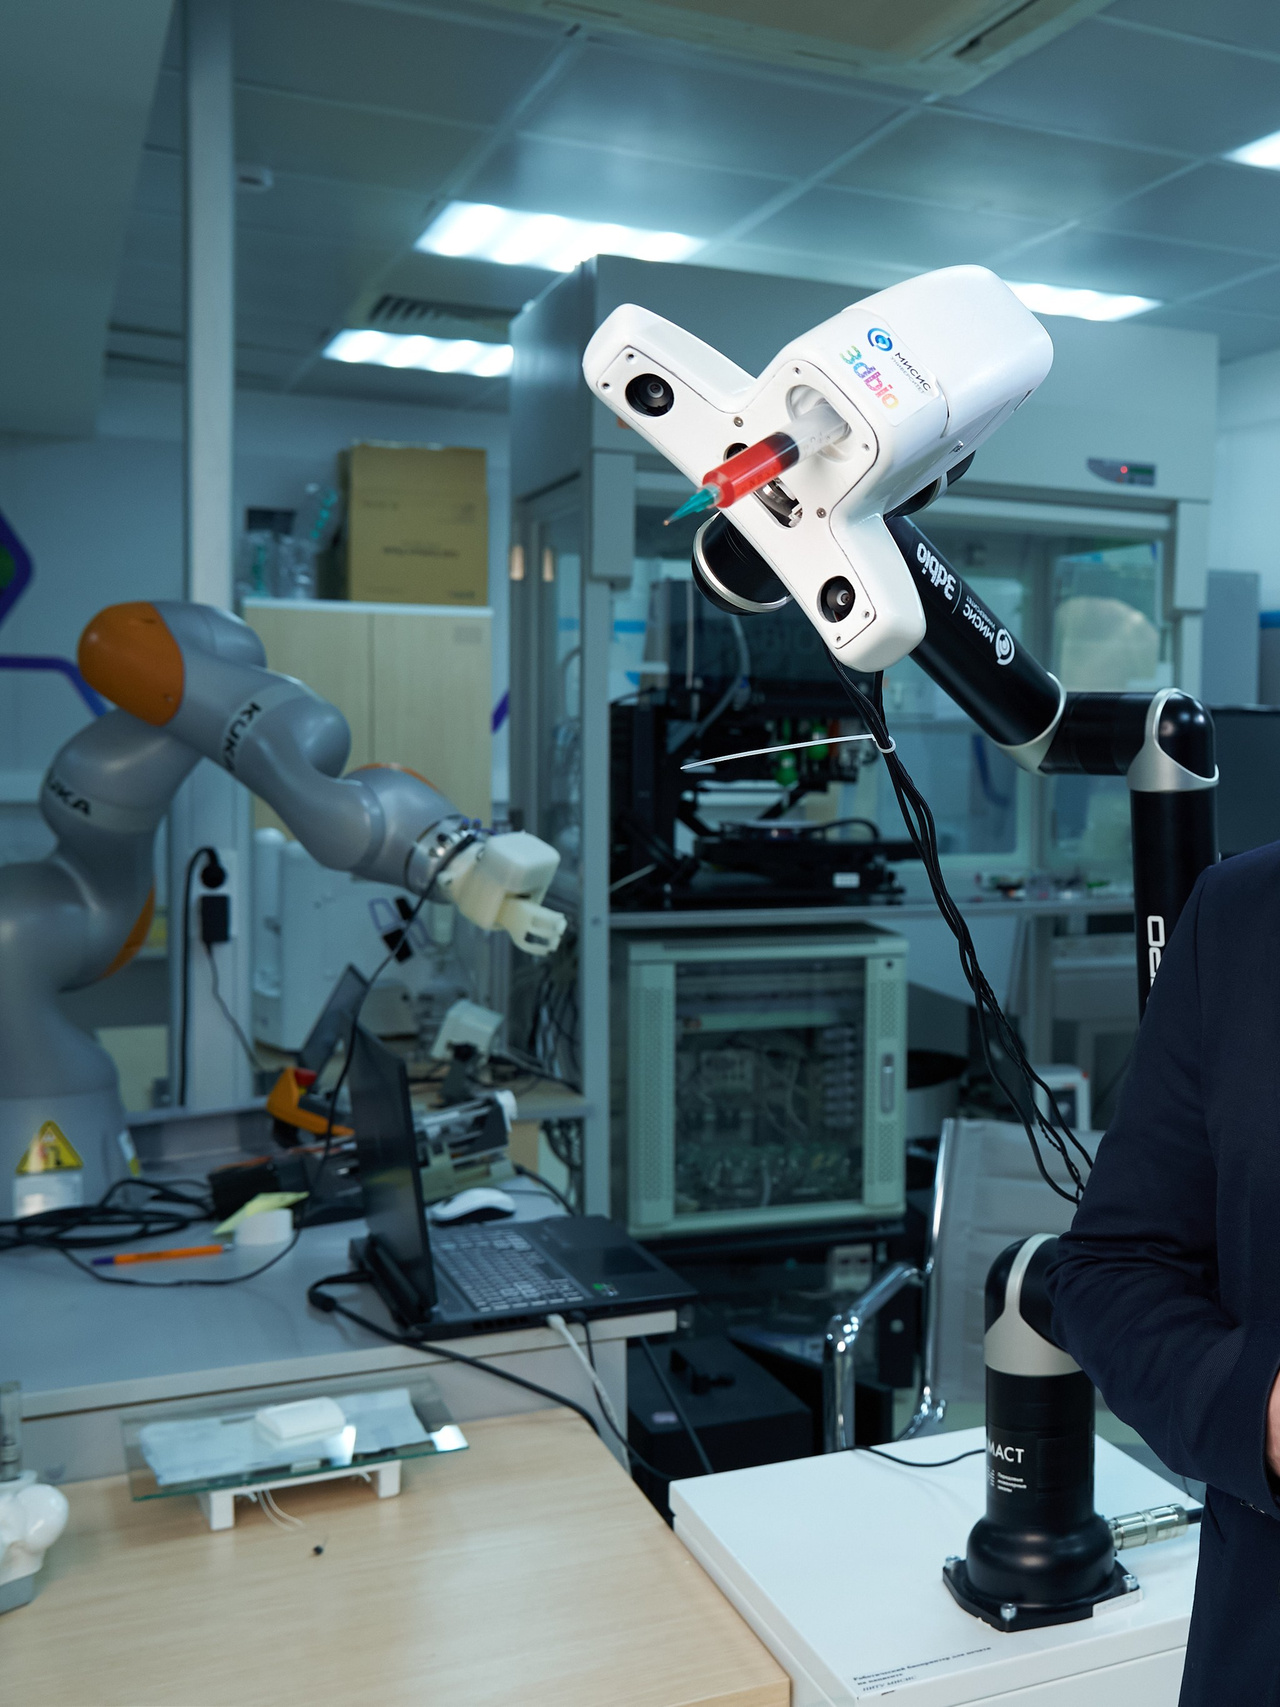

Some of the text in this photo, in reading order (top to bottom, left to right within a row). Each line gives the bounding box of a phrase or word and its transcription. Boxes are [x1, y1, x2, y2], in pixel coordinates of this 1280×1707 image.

[839, 345, 900, 410] 3dbio
[894, 352, 931, 391] МИСИС
[916, 542, 957, 600] 3dbio
[962, 603, 995, 643] МИСИС
